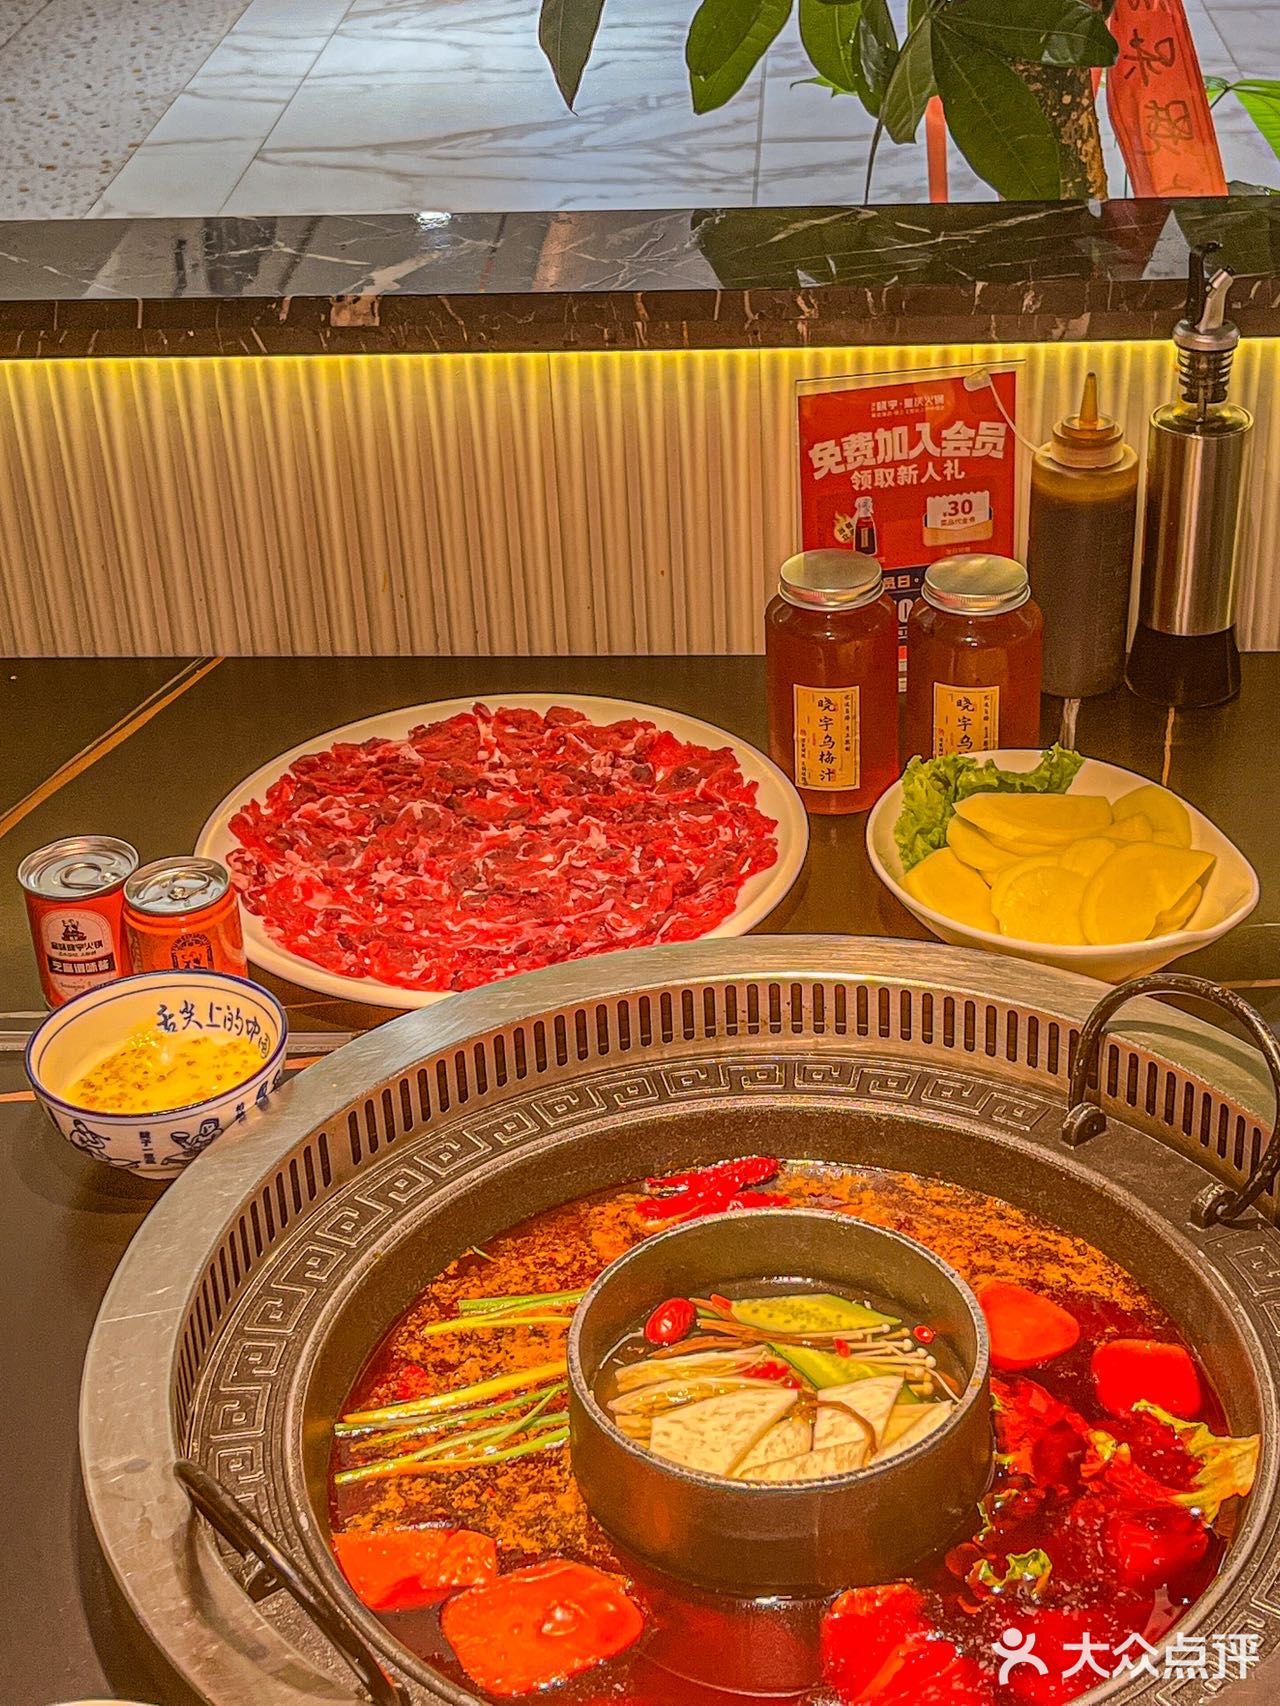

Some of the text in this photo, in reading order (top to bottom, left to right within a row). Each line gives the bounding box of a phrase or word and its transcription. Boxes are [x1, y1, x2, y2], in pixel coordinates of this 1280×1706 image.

[808, 421, 1007, 480] 免费加入会员
[851, 459, 965, 491] 领取新人礼
[817, 697, 837, 782] 晓宇乌梅汁
[956, 696, 975, 754] 晓宇乌
